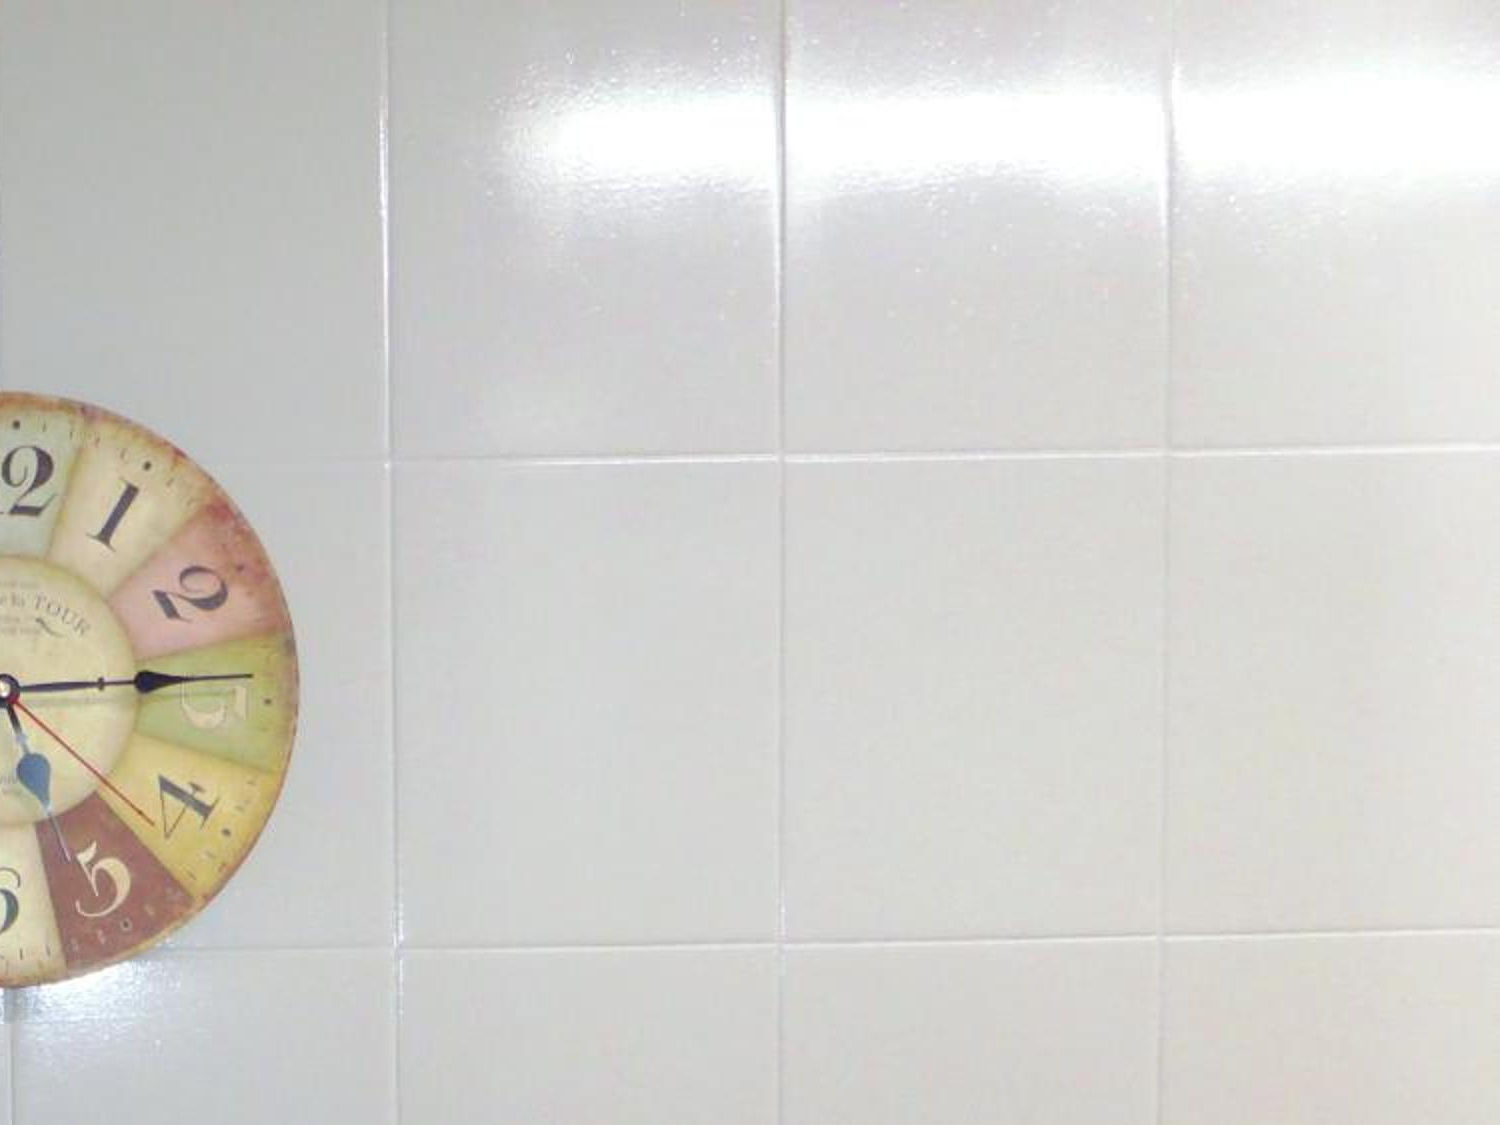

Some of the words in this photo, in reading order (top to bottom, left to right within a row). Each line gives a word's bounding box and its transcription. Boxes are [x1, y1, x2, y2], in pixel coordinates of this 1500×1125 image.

[85, 478, 140, 552] 1
[34, 594, 92, 636] TOUR
[152, 564, 230, 623] 2
[154, 772, 223, 840] 4
[75, 841, 132, 918] 5
